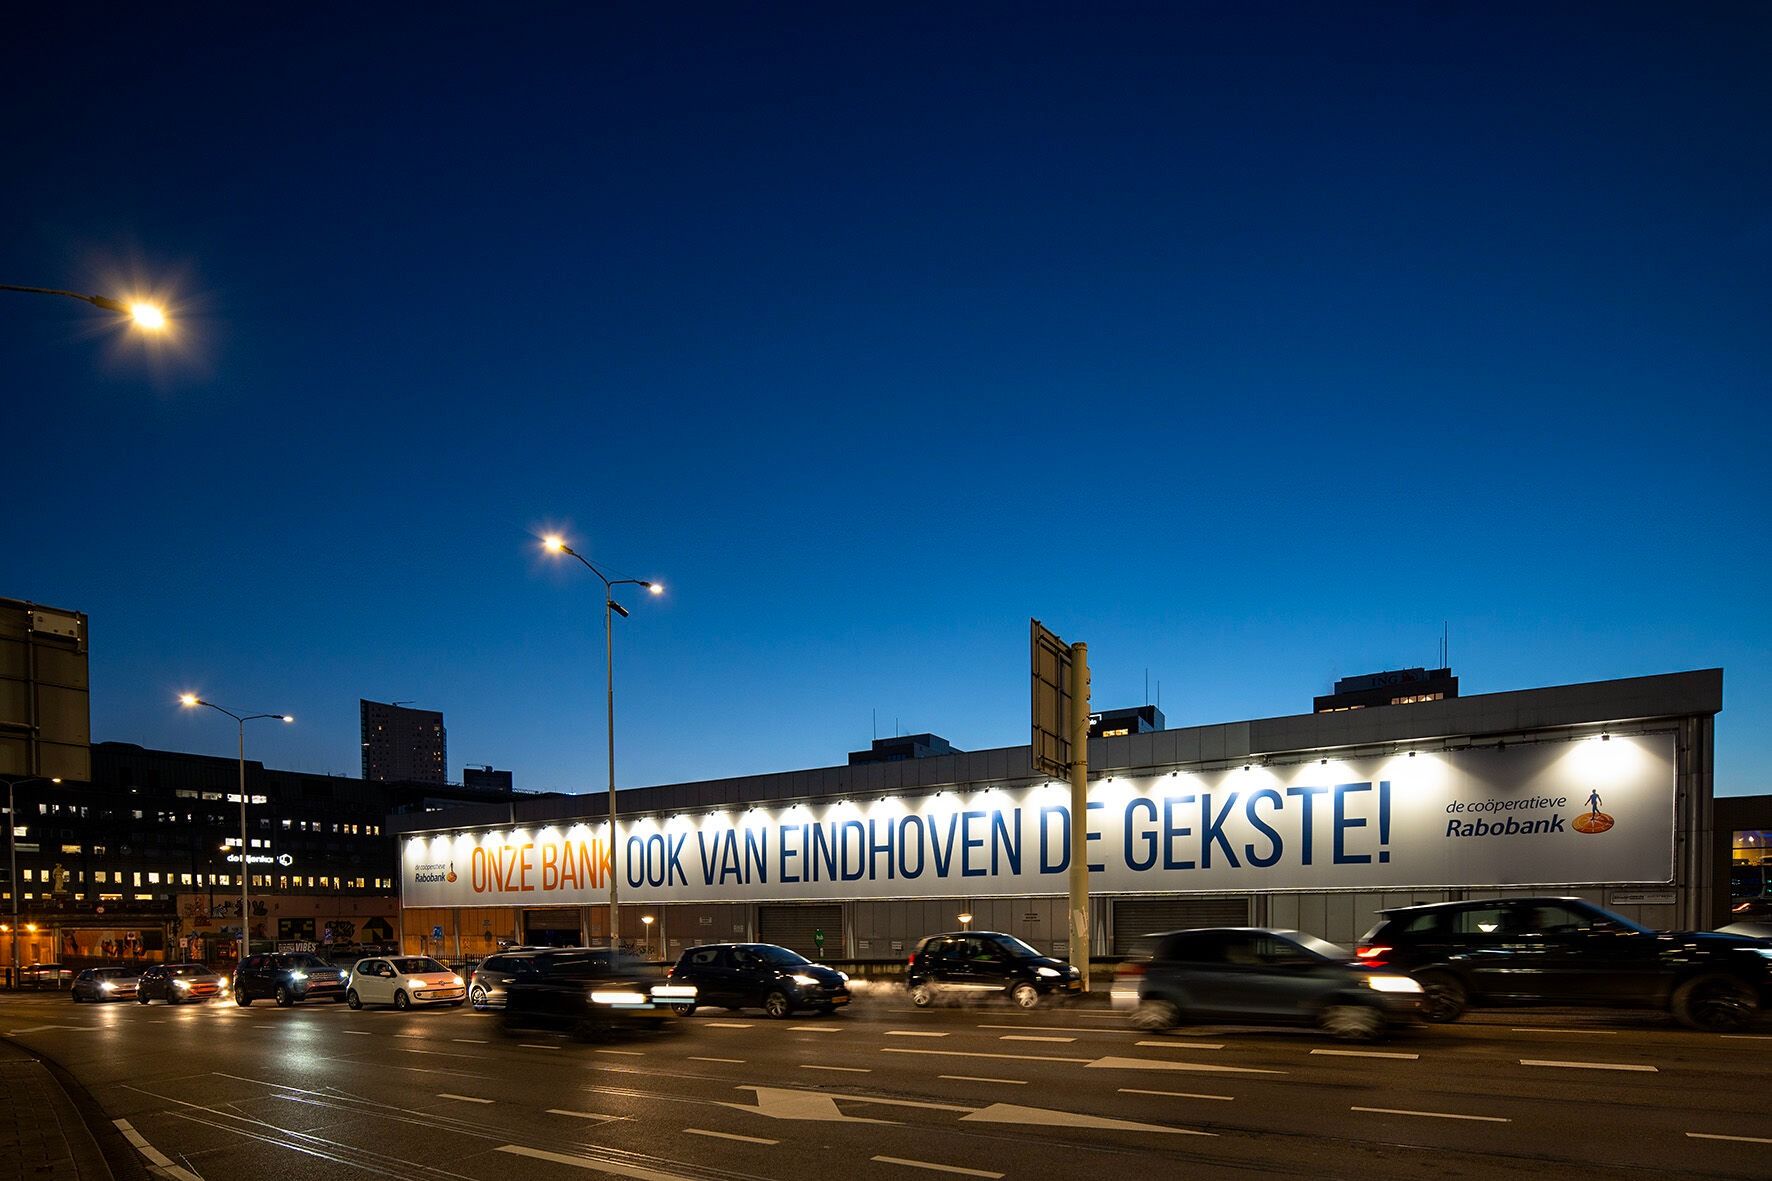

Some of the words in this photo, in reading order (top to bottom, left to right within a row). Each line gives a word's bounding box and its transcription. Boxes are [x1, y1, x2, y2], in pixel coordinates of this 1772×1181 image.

[1446, 801, 1465, 814] de
[1467, 796, 1567, 814] coöperatieve
[471, 844, 534, 893] ONZE
[627, 831, 688, 888] OOK
[697, 826, 768, 886] VAN
[779, 807, 1022, 883] EINDHOVEN
[1039, 801, 1105, 874] DE
[1124, 780, 1391, 872] GEKSTE!
[1446, 814, 1566, 838] Rabobank
[415, 872, 446, 883] Rabobank
